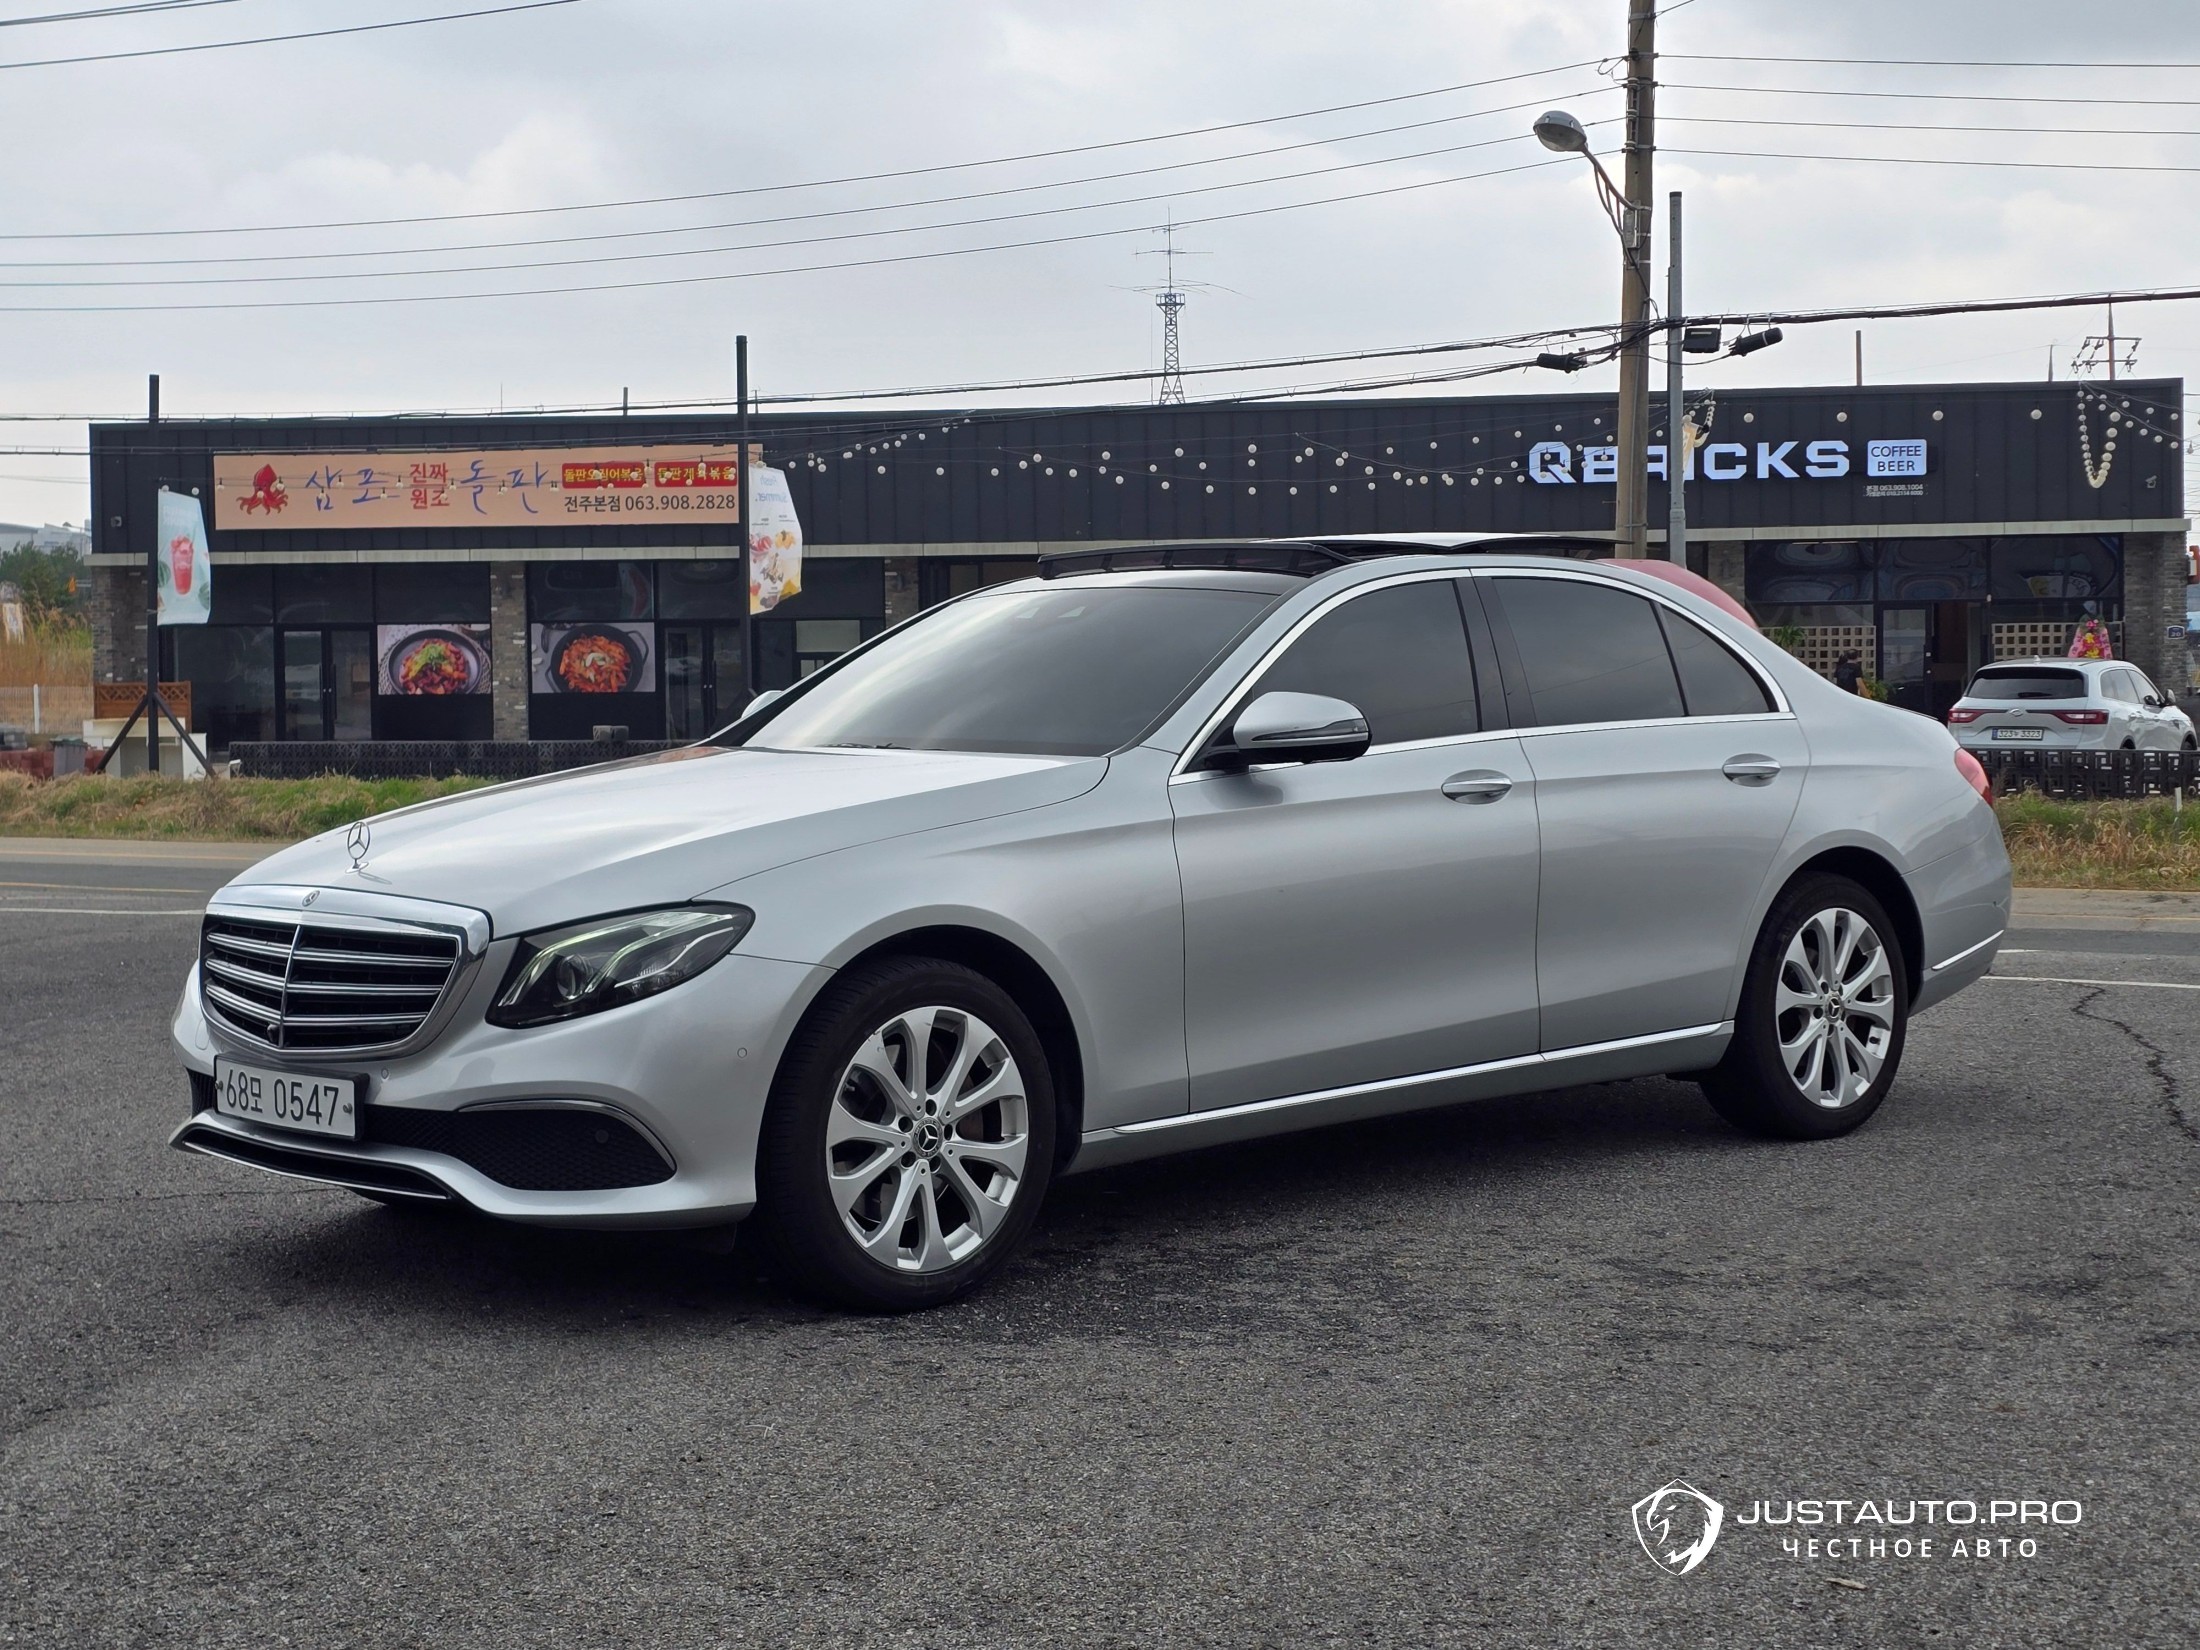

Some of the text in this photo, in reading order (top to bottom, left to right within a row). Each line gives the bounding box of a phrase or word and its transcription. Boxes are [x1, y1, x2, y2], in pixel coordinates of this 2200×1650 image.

[1871, 446, 1921, 457] COFFEE
[409, 462, 449, 483] 진짜
[1878, 461, 1915, 472] BEER
[460, 459, 549, 515] 돌판
[410, 488, 450, 509] 원조
[564, 494, 736, 512] 전주본점 063.908.2828
[226, 1069, 339, 1126] 68모 0547
